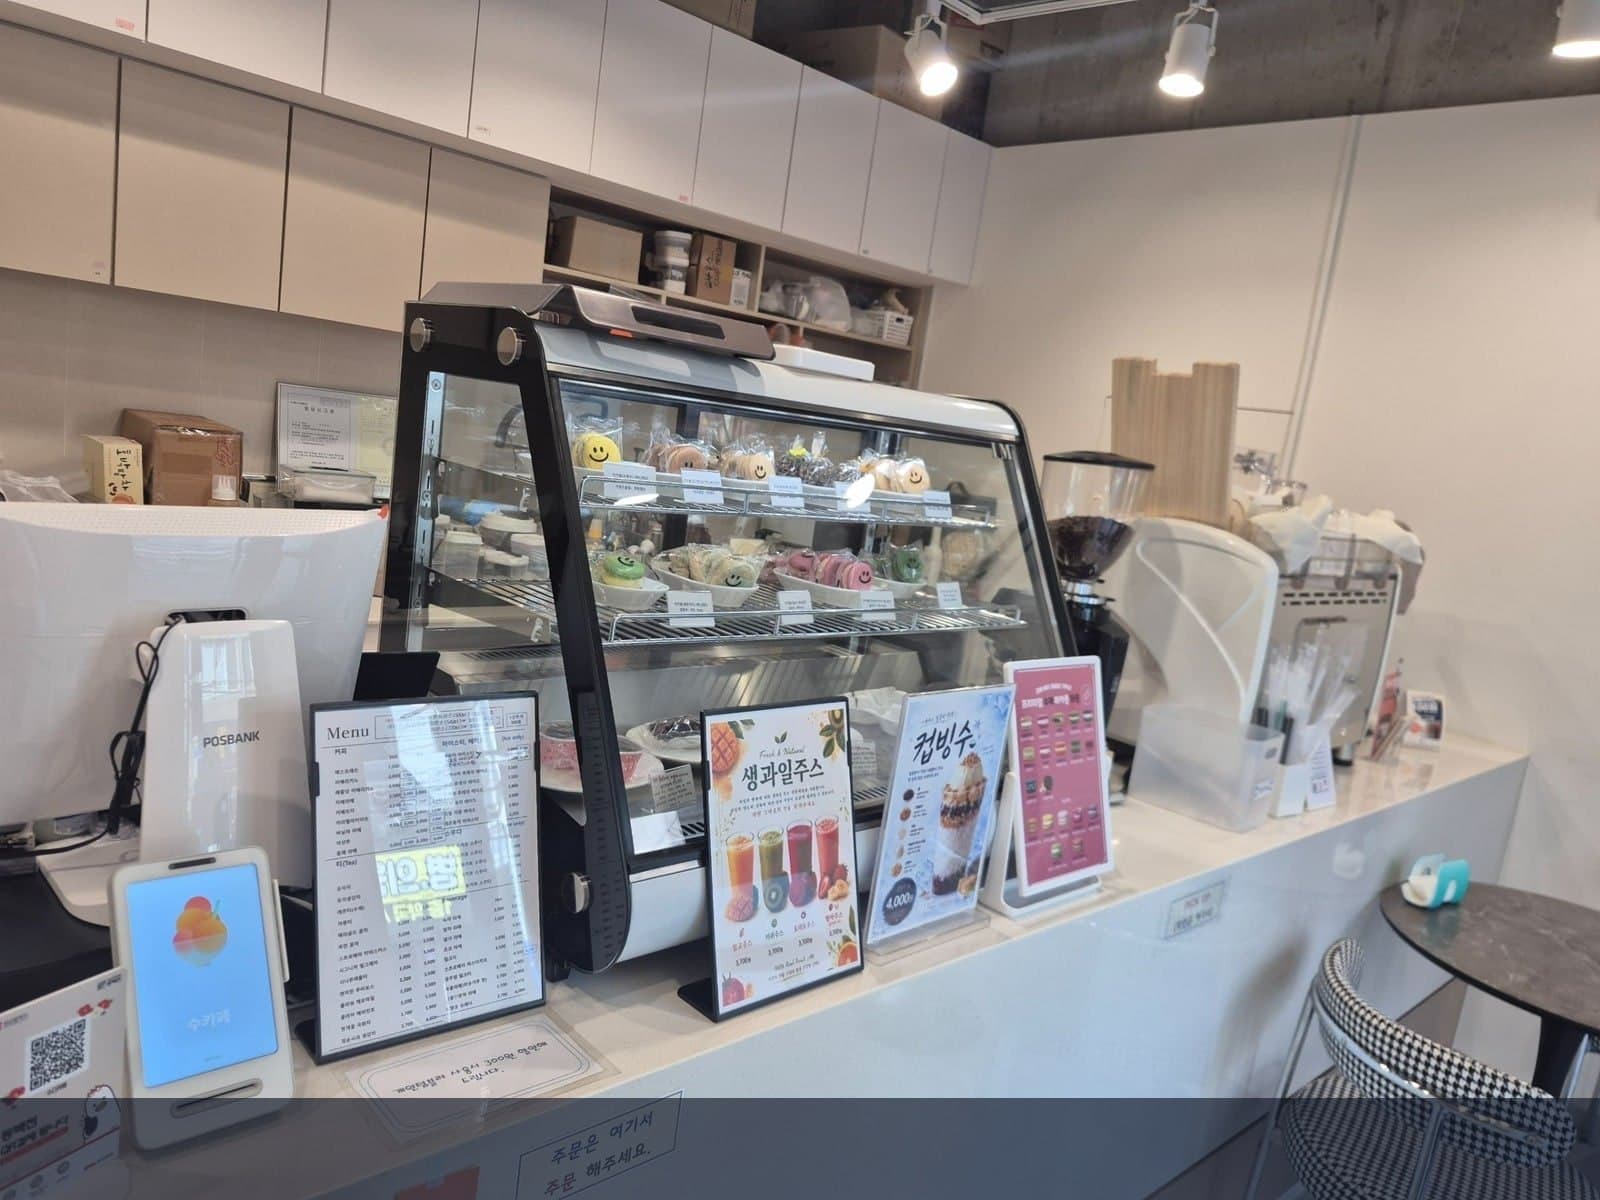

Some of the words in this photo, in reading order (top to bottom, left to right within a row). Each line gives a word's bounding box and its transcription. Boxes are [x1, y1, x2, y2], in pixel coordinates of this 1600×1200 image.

[203, 731, 260, 749] POSBANK
[327, 726, 369, 742] Menu
[912, 719, 974, 766] 컵빙수
[742, 758, 825, 792] 생과일주스
[450, 1063, 480, 1077] 사용시
[485, 1052, 516, 1066] 300원
[551, 1134, 600, 1166] 주문은
[608, 1111, 653, 1140] 여기서
[543, 1174, 577, 1197] 주문
[585, 1143, 651, 1177] 해주세요.
